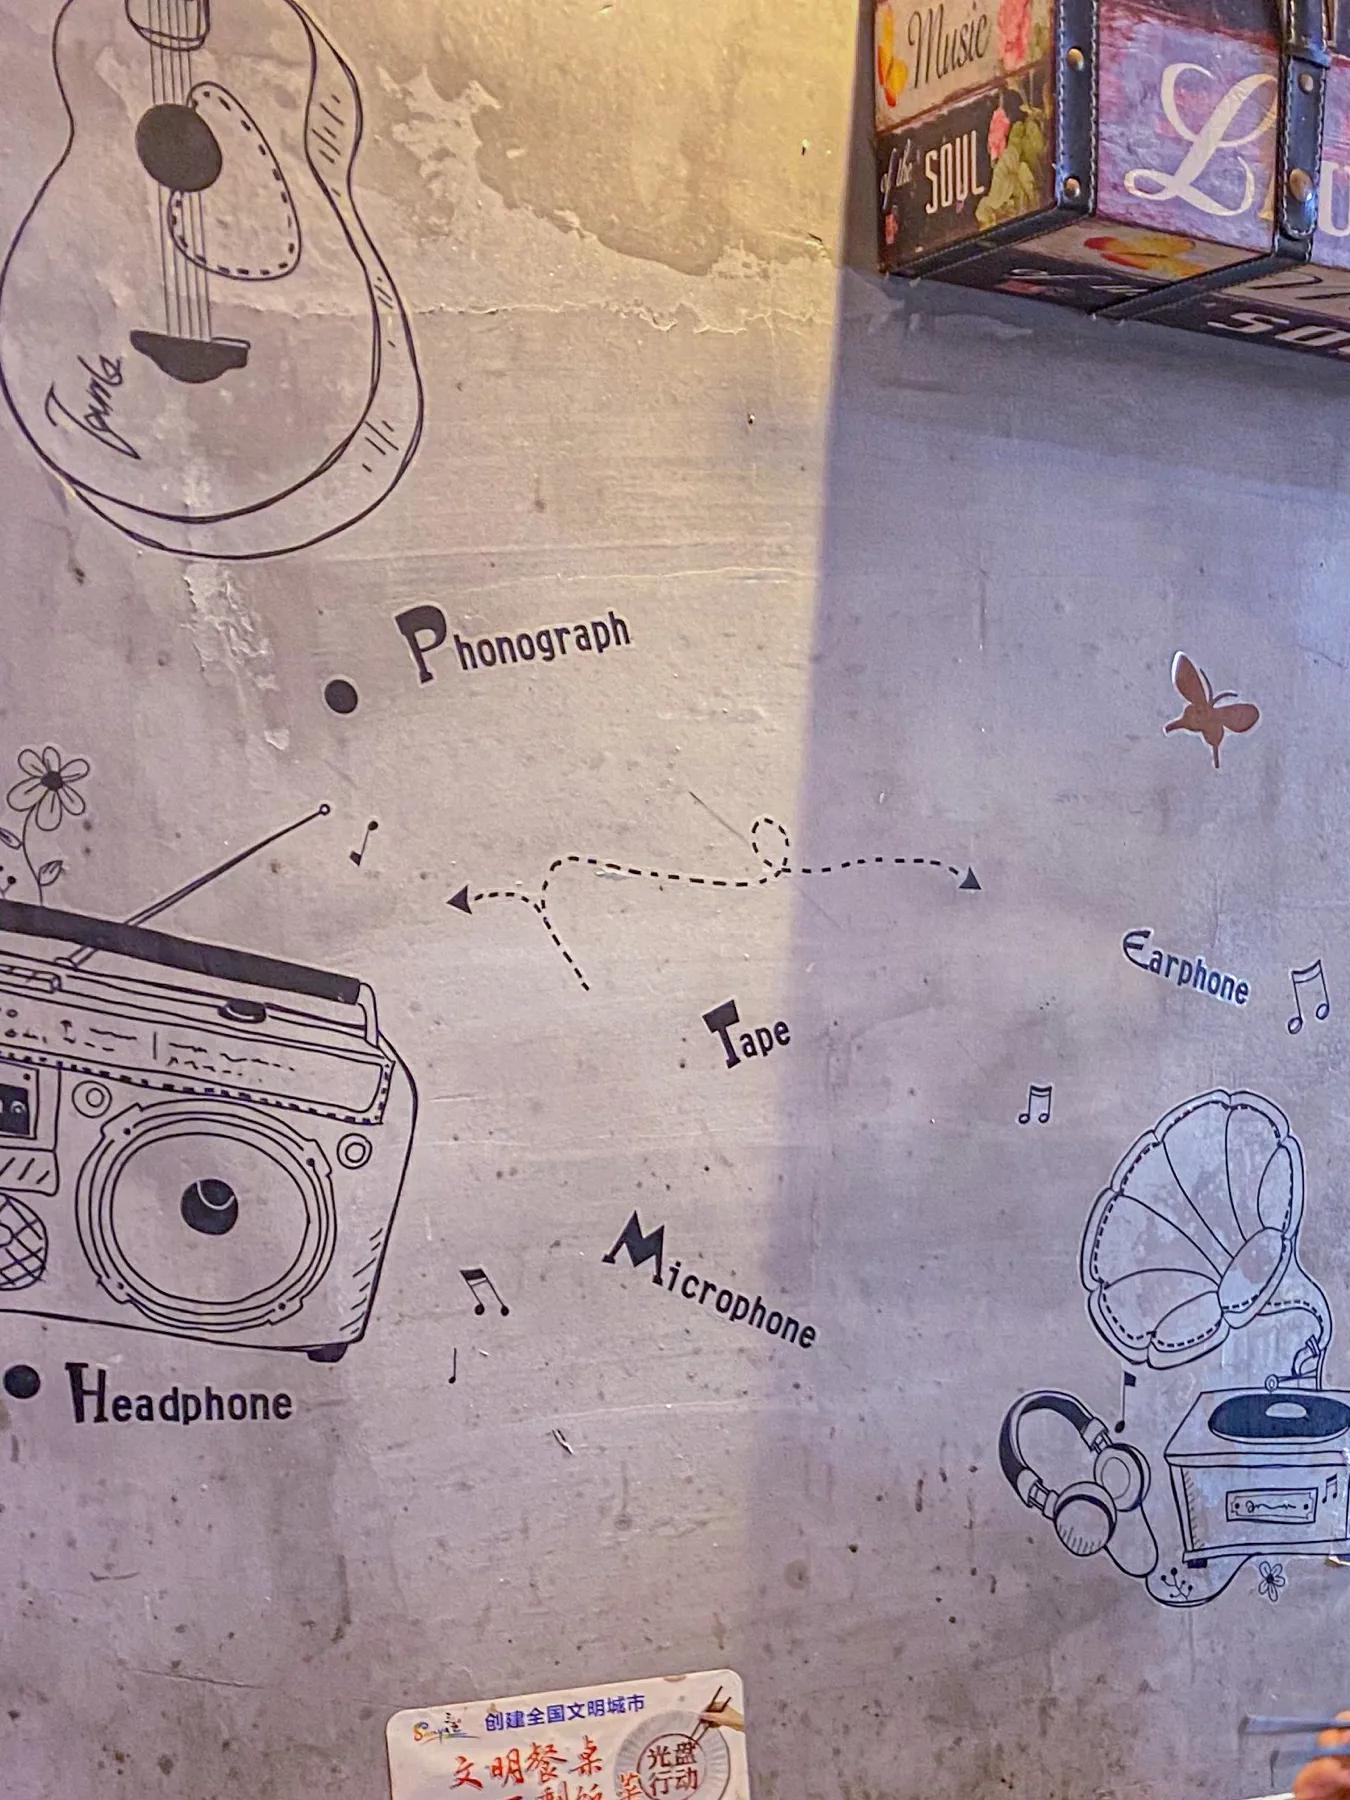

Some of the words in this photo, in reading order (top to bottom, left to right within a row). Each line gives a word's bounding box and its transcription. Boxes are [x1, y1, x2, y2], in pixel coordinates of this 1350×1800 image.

[906, 6, 989, 89] Music
[924, 130, 985, 215] SOUL
[395, 604, 632, 684] Phonograph
[1122, 930, 1250, 1007] Earphone
[703, 999, 791, 1069] Tape
[602, 1210, 818, 1350] Microphone
[65, 1362, 293, 1426] Headphone
[485, 1694, 645, 1732] 创建全国文明城市
[449, 1735, 603, 1790] 文明餐桌
[647, 1741, 698, 1769] 光盘
[650, 1767, 698, 1797] 行动
